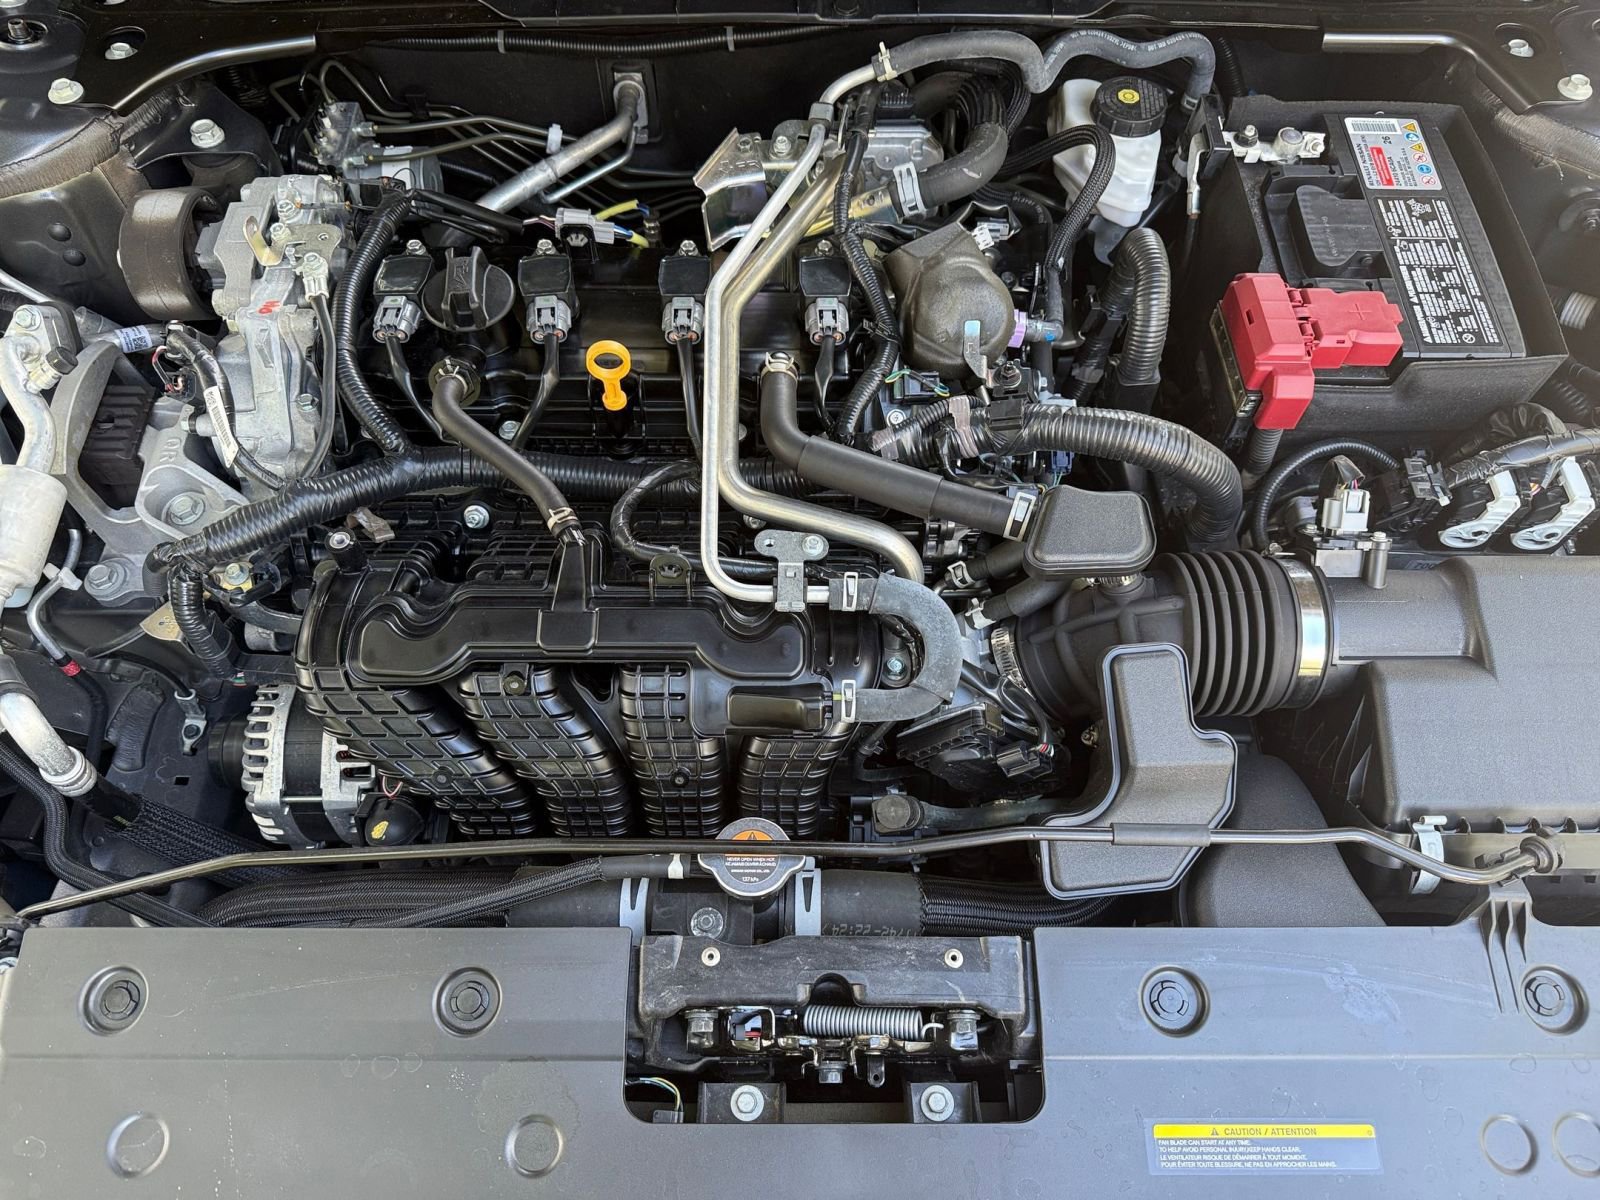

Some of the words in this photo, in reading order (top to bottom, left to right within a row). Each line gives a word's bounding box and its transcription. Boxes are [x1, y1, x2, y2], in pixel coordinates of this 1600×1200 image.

[1381, 136, 1393, 144] 26
[1356, 143, 1367, 164] NISSAN
[1363, 165, 1374, 186] RENAULT
[1223, 1128, 1262, 1136] CAUTION
[1270, 1128, 1317, 1136] ATTENTION
